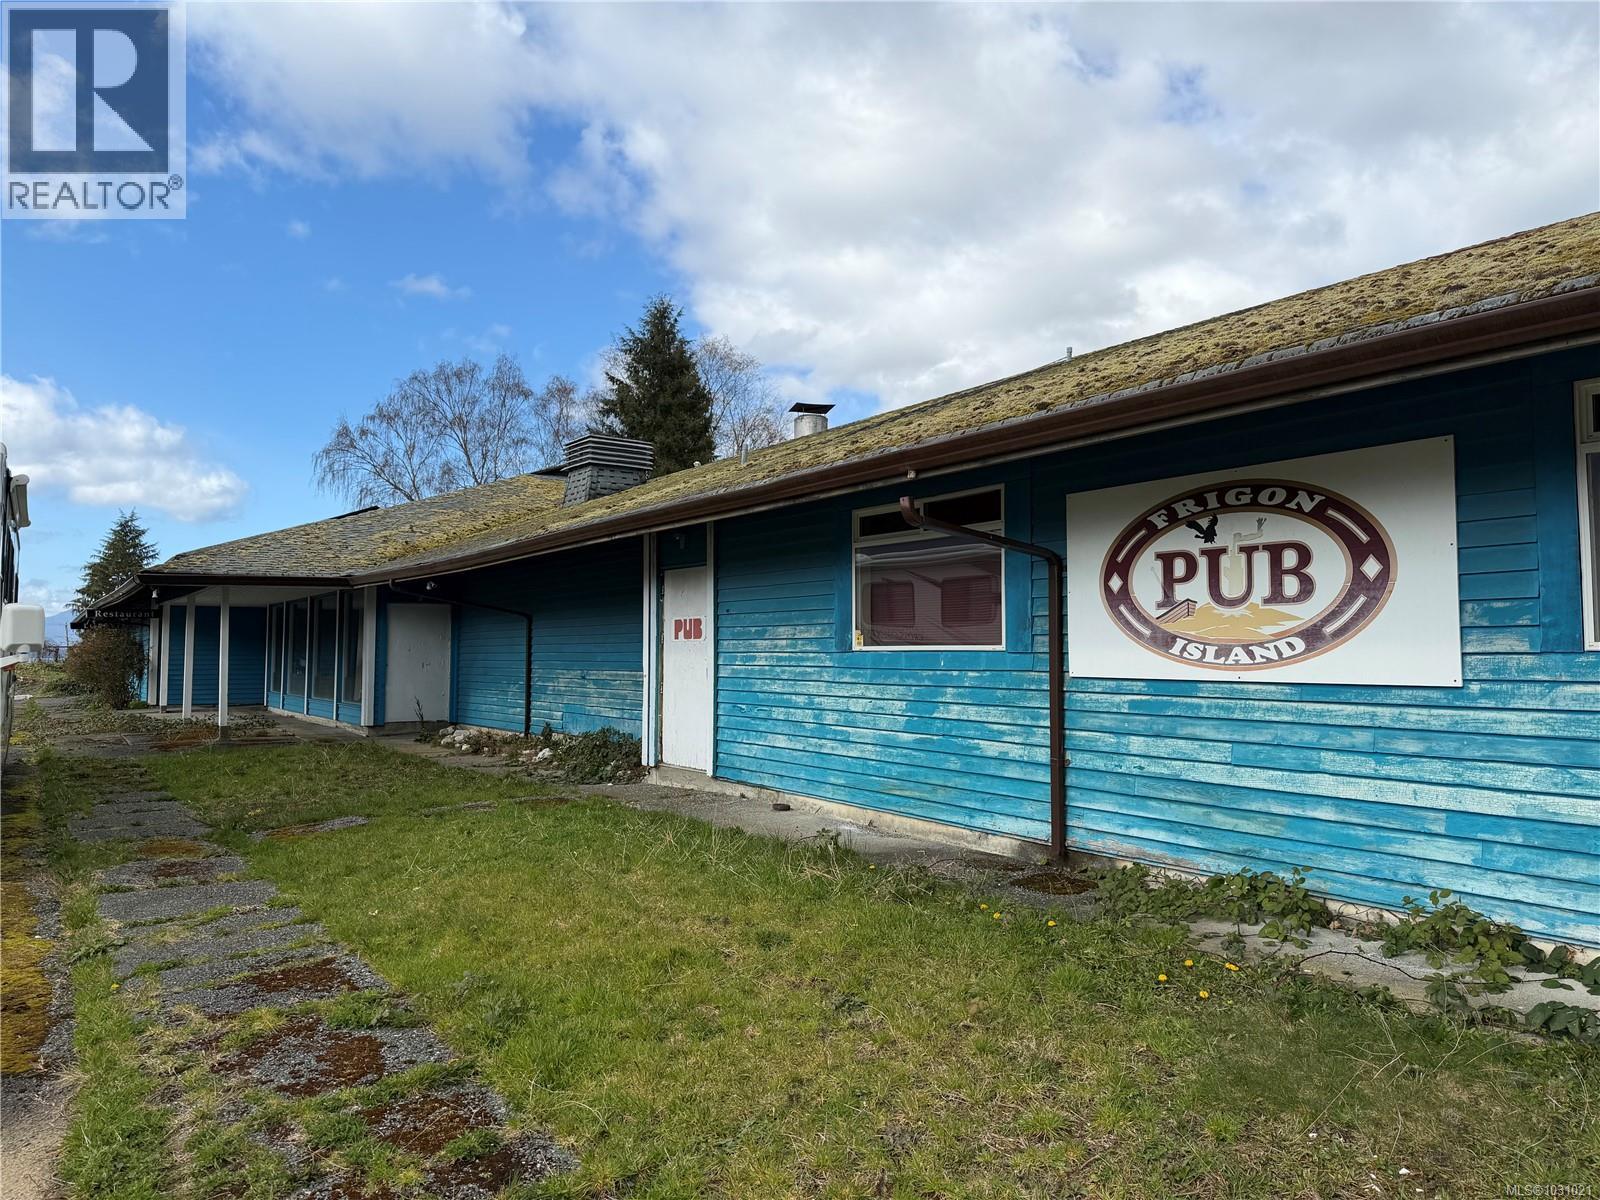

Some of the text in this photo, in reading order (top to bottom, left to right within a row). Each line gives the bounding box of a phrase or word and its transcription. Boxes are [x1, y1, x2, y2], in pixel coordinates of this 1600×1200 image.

[1146, 486, 1326, 529] FRIGON
[1153, 539, 1317, 611] PUB
[95, 609, 155, 618] Restaurant
[674, 618, 703, 640] PUB
[1168, 636, 1306, 665] ISLAND
